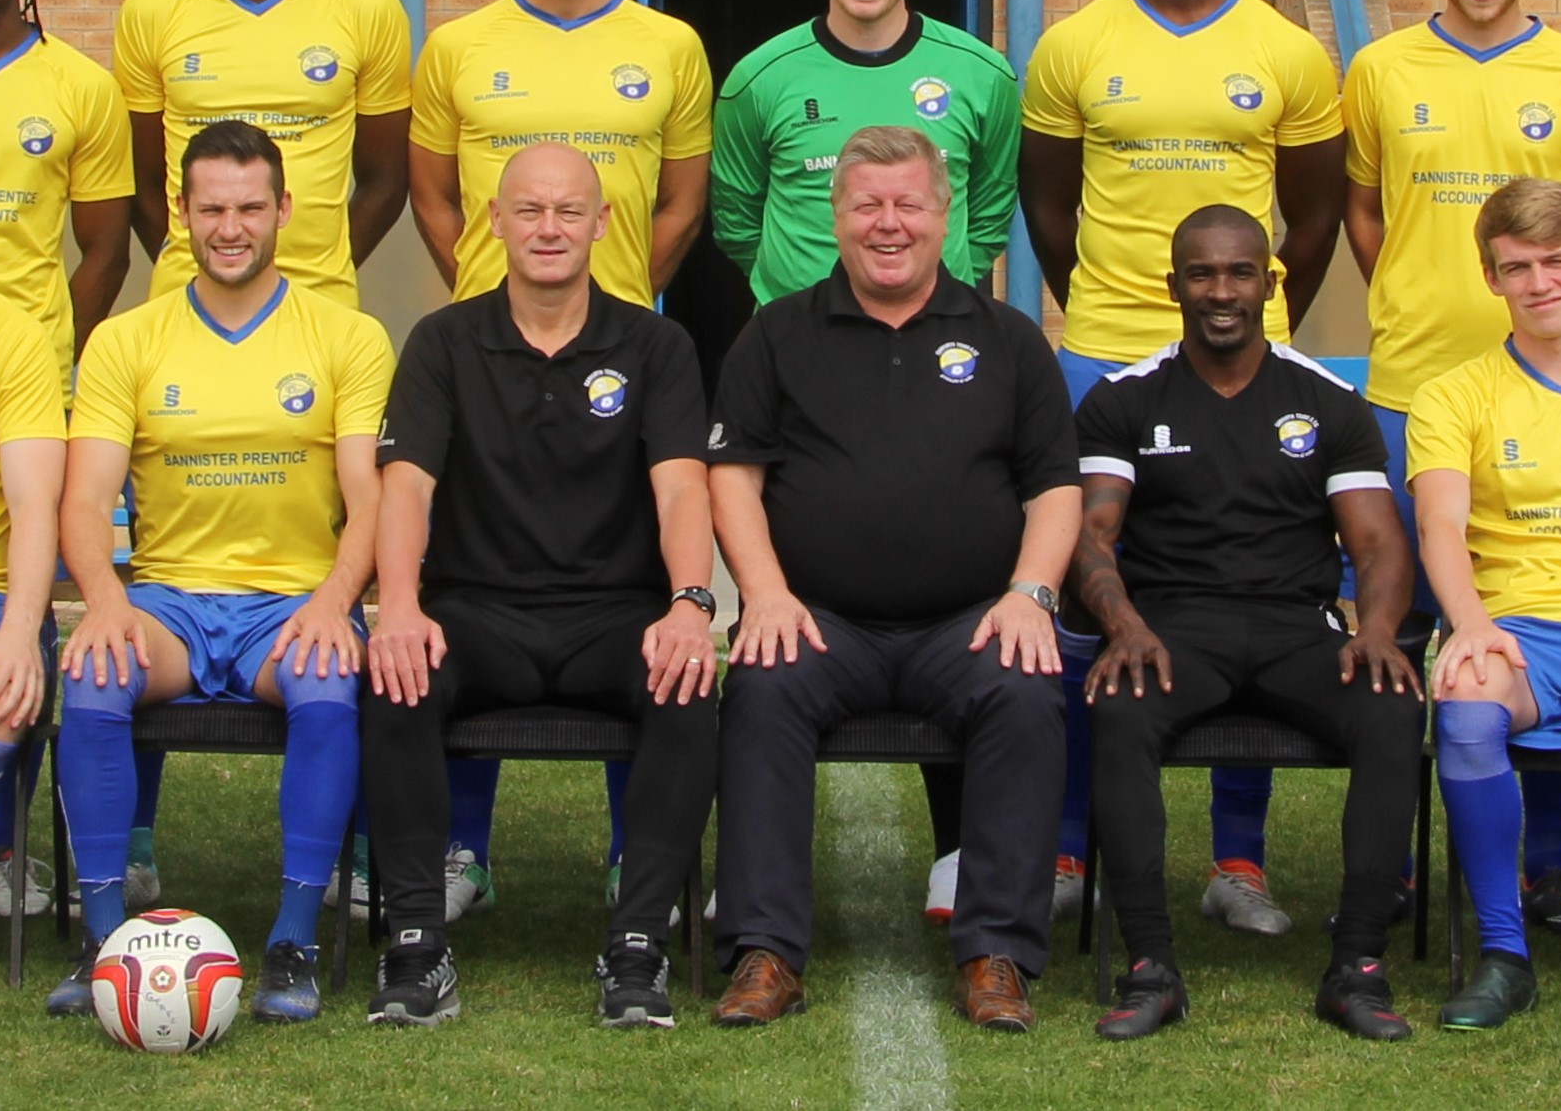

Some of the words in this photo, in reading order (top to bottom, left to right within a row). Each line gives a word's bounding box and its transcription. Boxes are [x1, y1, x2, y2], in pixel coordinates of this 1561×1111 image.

[574, 132, 639, 148] PRENTICE
[1112, 139, 1181, 152] BANNISTER
[1128, 158, 1226, 171] ACCOUNTANTS
[1412, 171, 1480, 185] BANNISTER
[1431, 191, 1492, 205] ACCOUNT
[164, 453, 238, 467] BANNISTER
[242, 450, 308, 466] PRENTICE
[186, 471, 286, 487] ACCOUNTANTS
[127, 929, 202, 953] mitre
